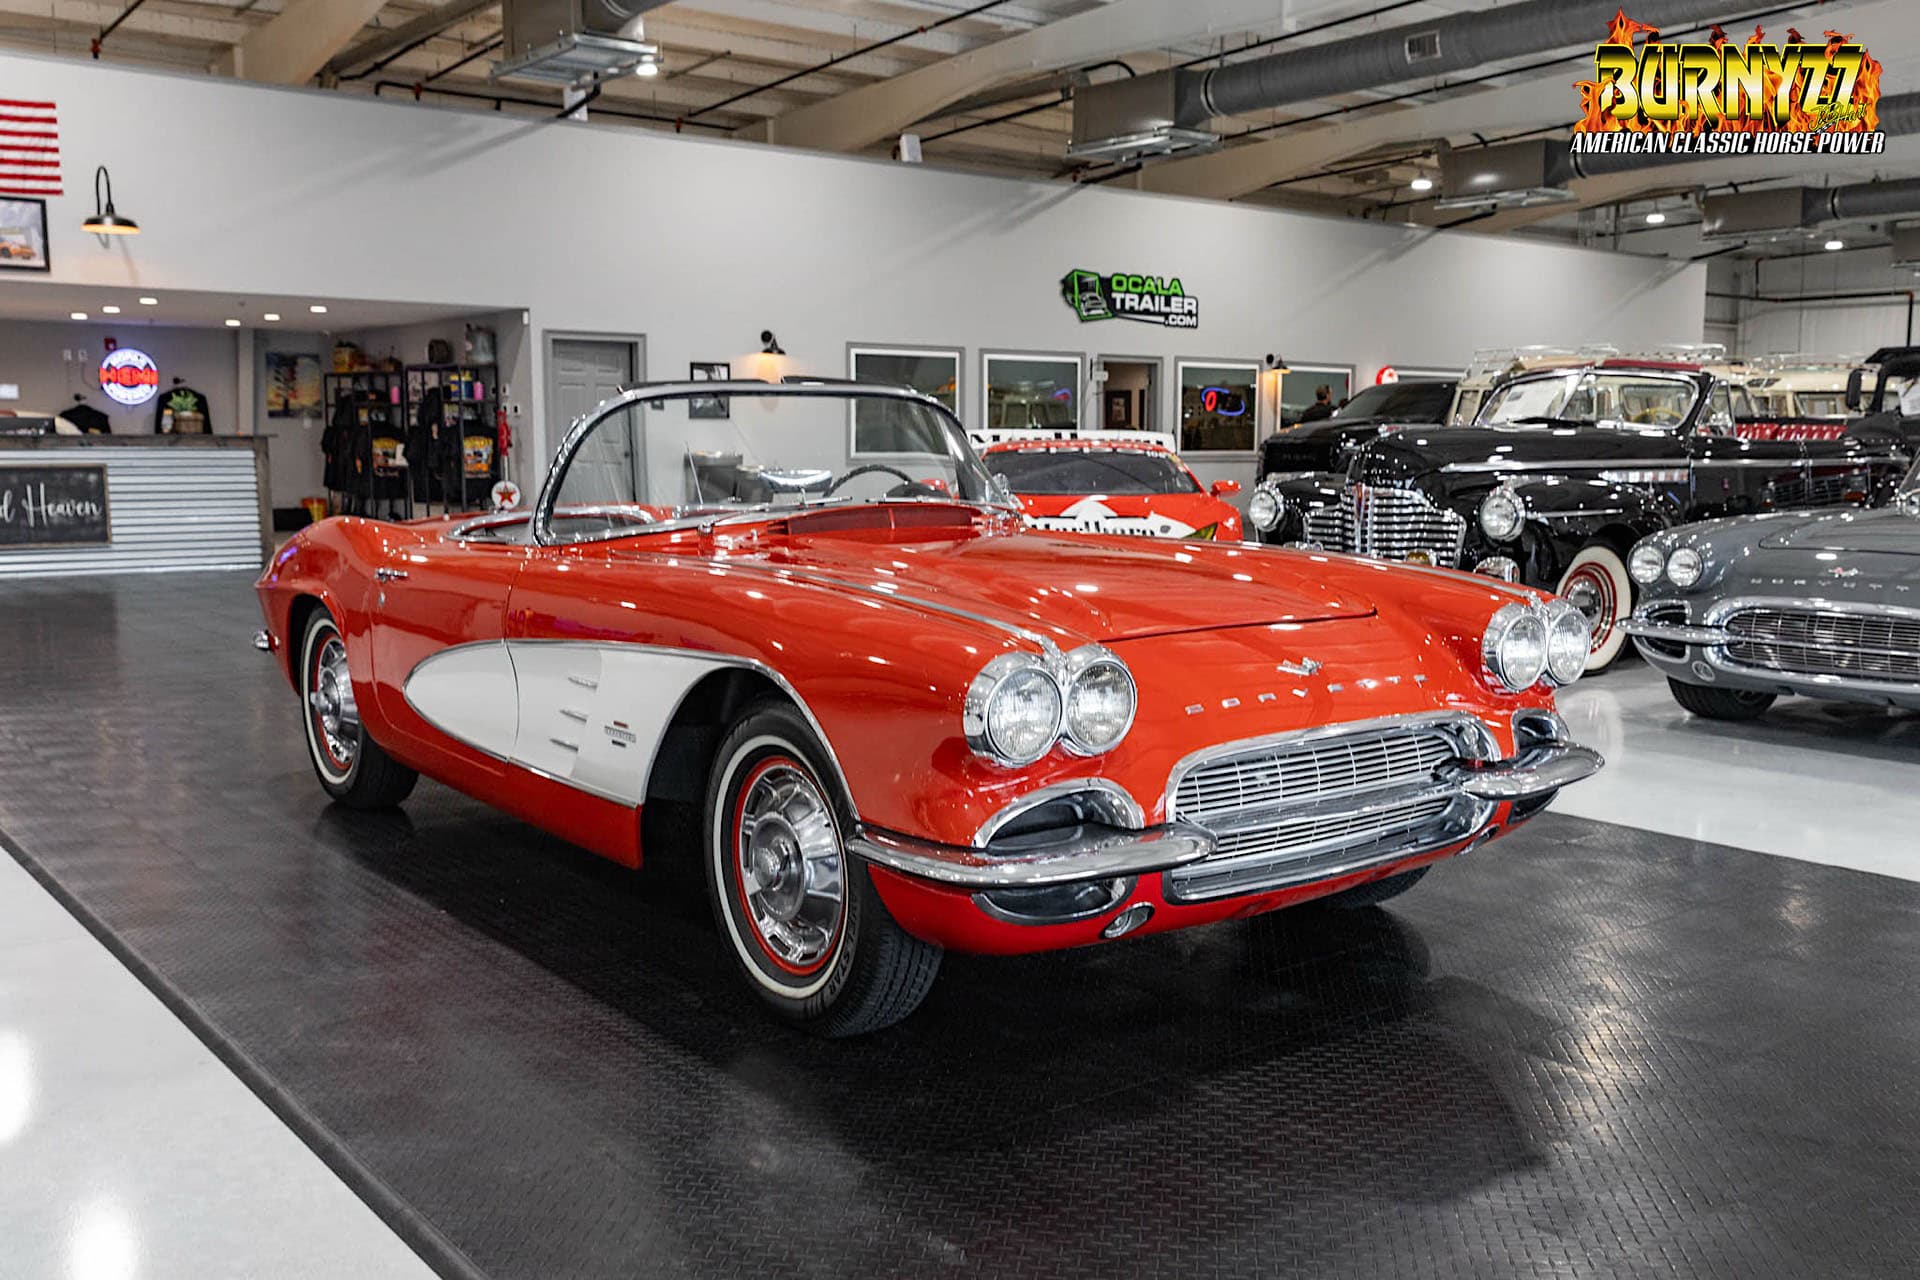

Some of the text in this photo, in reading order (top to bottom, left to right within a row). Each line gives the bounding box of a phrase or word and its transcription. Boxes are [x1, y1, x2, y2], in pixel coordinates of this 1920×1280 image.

[1111, 275, 1184, 296] OCALA
[1111, 292, 1197, 314] TRAILER
[1164, 315, 1197, 327] .COM
[99, 366, 159, 386] HEMI
[21, 482, 102, 527] Heaven
